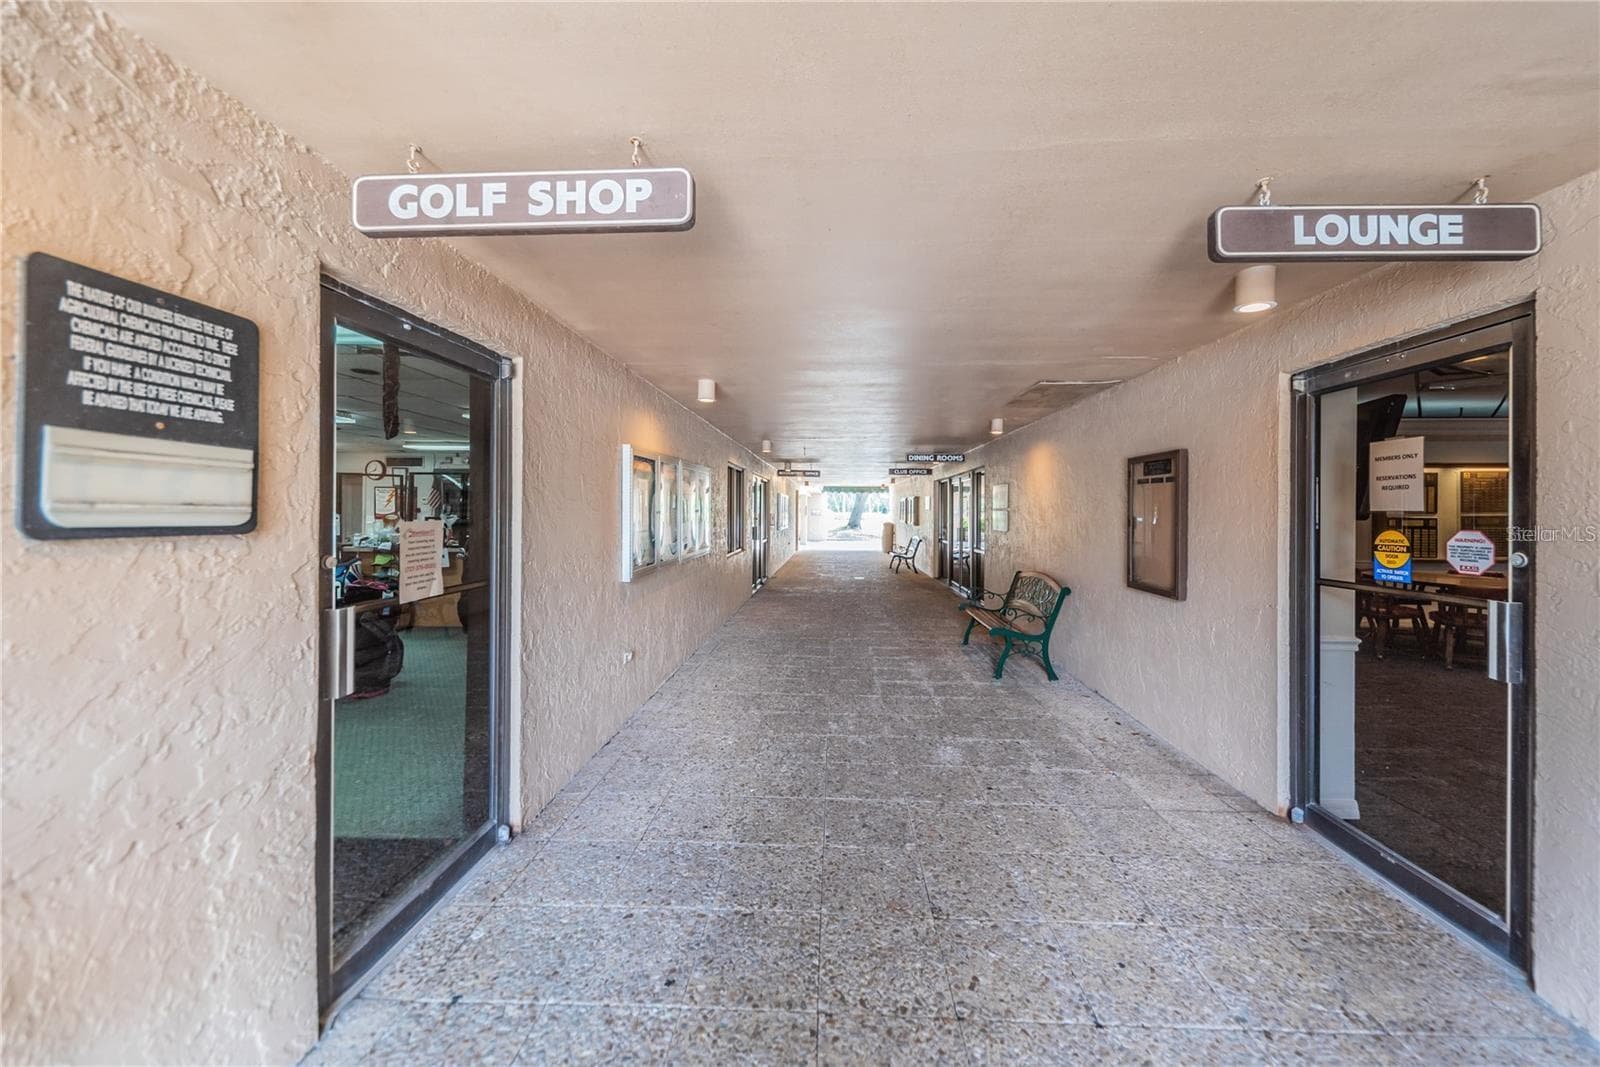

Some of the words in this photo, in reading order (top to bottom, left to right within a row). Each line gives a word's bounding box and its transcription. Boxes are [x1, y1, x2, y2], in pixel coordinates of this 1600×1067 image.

[388, 182, 507, 220] GOLF
[528, 178, 653, 216] SHOP
[1293, 213, 1464, 246] LOUNGE
[1375, 454, 1401, 462] MEMBERS
[1377, 544, 1407, 552] CAUTION
